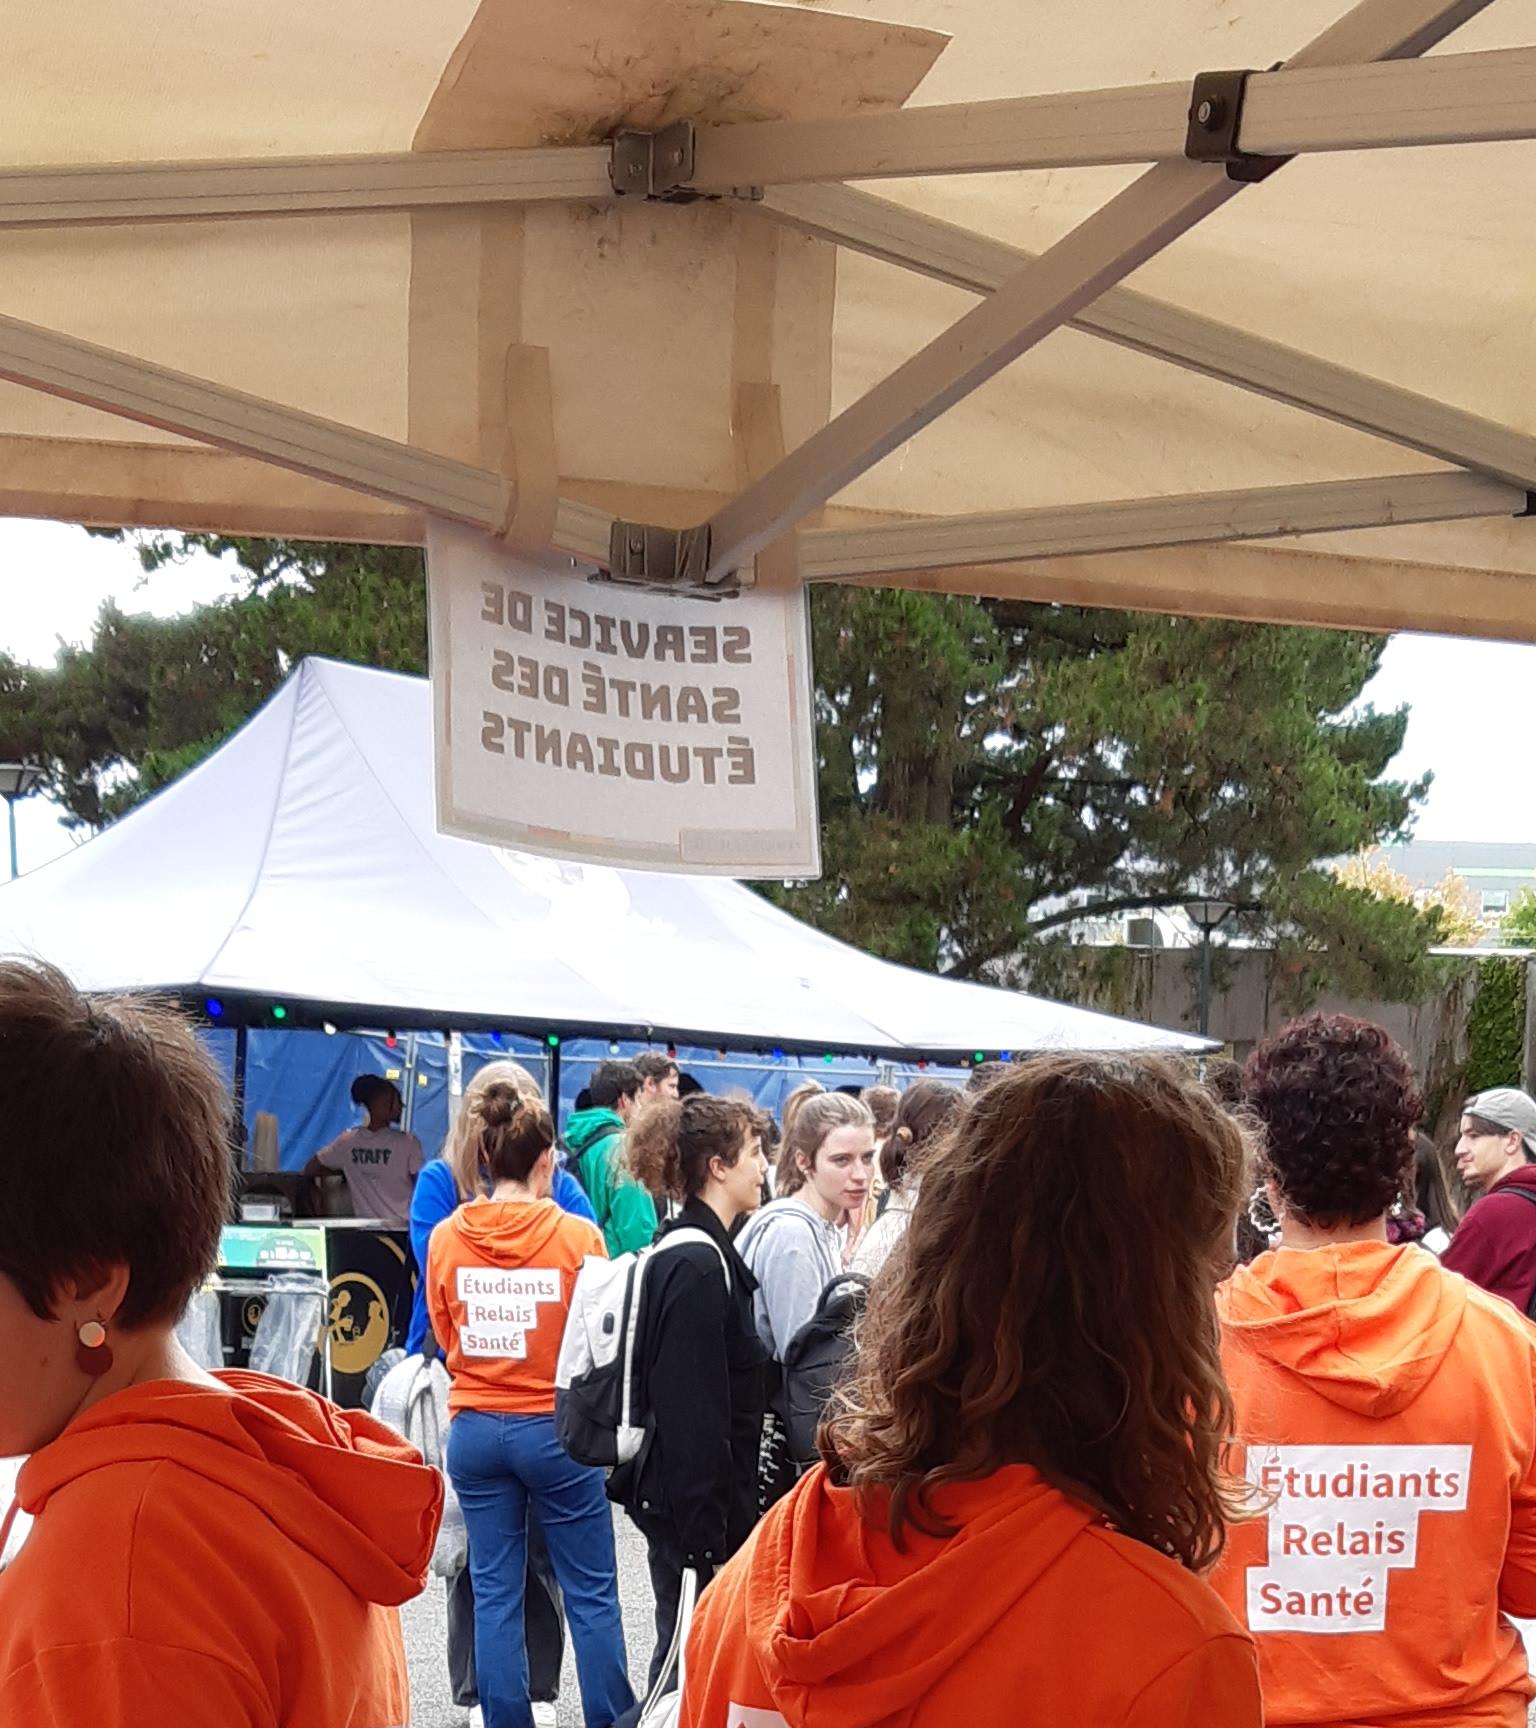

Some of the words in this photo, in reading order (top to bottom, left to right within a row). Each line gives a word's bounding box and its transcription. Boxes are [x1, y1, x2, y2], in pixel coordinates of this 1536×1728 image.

[352, 1147, 392, 1166] STAFF
[463, 1272, 555, 1296] Étudiants
[474, 1304, 531, 1323] Relais
[466, 1332, 520, 1352] Santé
[1261, 1455, 1460, 1498] Étudiants
[1282, 1521, 1406, 1556] Relais
[1260, 1577, 1374, 1617] Santé
